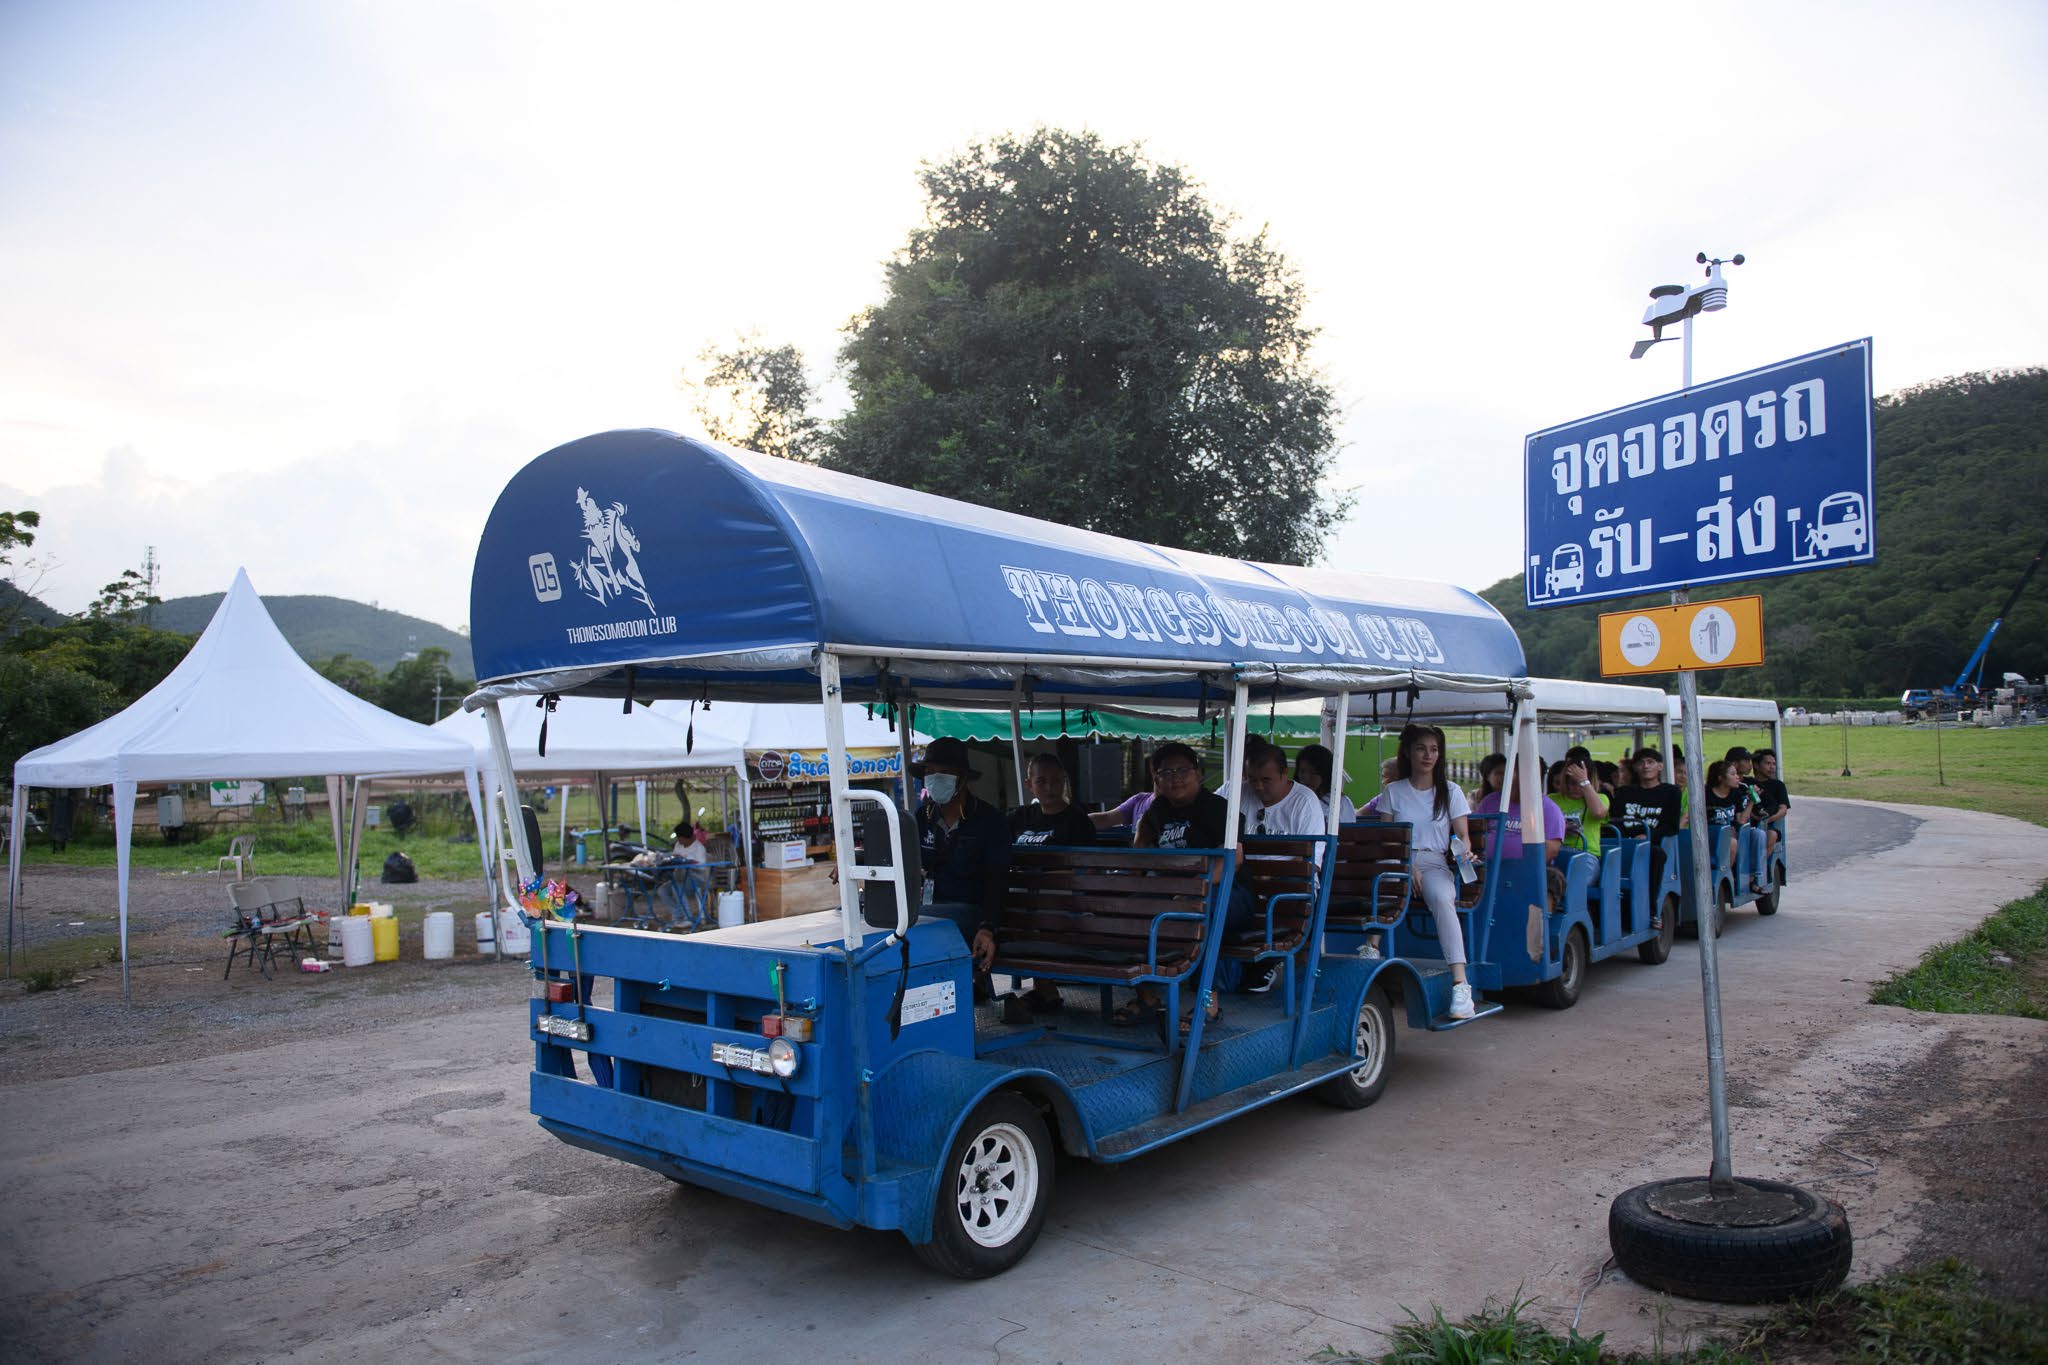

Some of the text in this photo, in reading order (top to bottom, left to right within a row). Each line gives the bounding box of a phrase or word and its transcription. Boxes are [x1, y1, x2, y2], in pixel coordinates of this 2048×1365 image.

[1552, 377, 1826, 515] จุดจอดรถ
[533, 562, 558, 593] 05
[1000, 565, 1445, 664] THONGSOMBOON CLUB
[566, 616, 678, 644] THONGSOMBOON CLUB
[760, 759, 782, 768] OTOP
[1625, 802, 1662, 817] Sigma
